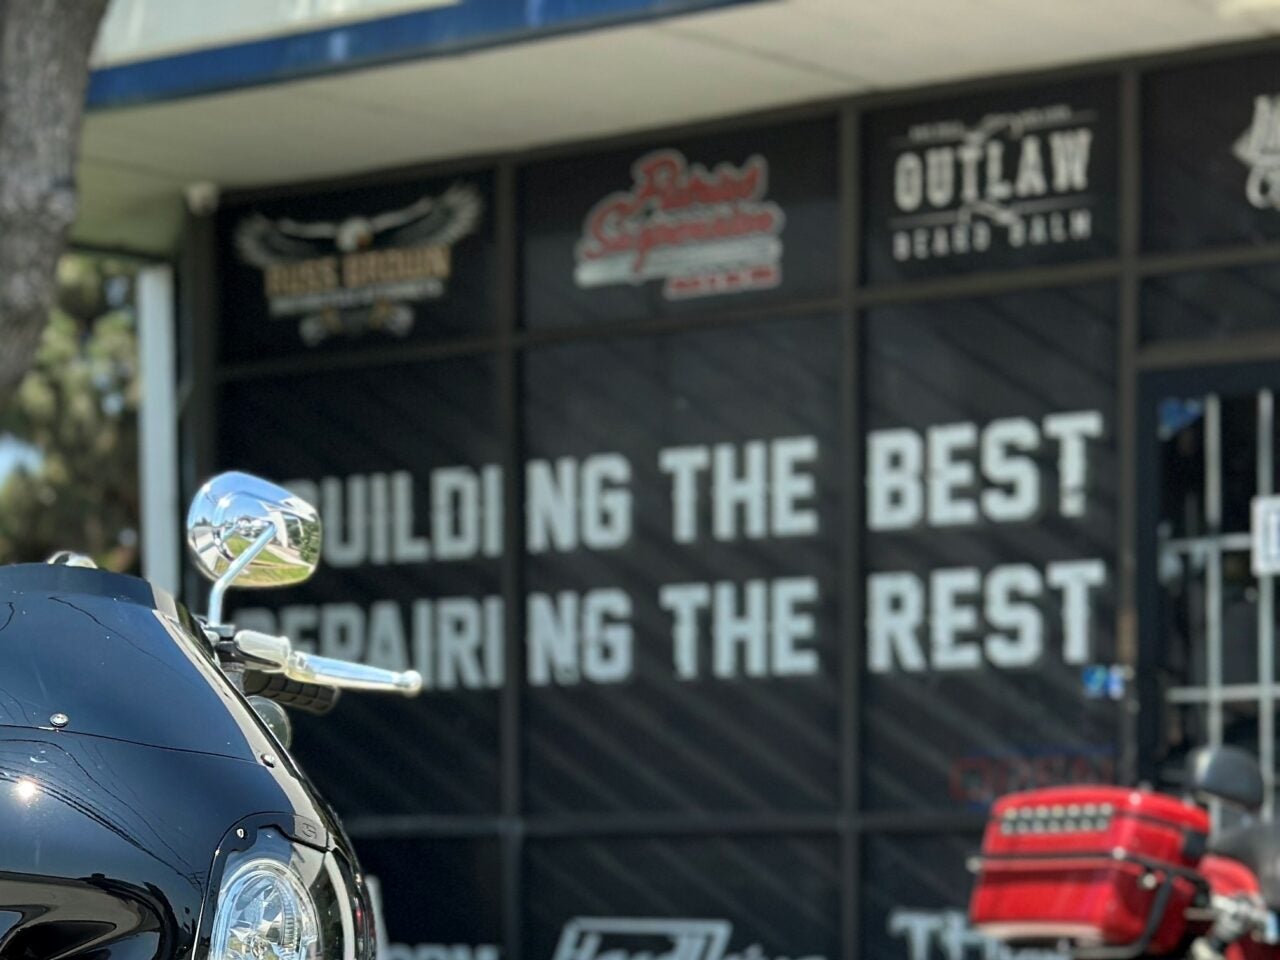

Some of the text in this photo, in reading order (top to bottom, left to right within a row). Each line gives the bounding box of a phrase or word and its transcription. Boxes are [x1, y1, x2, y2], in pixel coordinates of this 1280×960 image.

[894, 127, 1092, 213] OUTLAW
[893, 207, 1091, 262] BEARD BALM
[282, 411, 1102, 567] UILDING THE BEST
[234, 558, 1106, 690] EPAIRING THE REST
